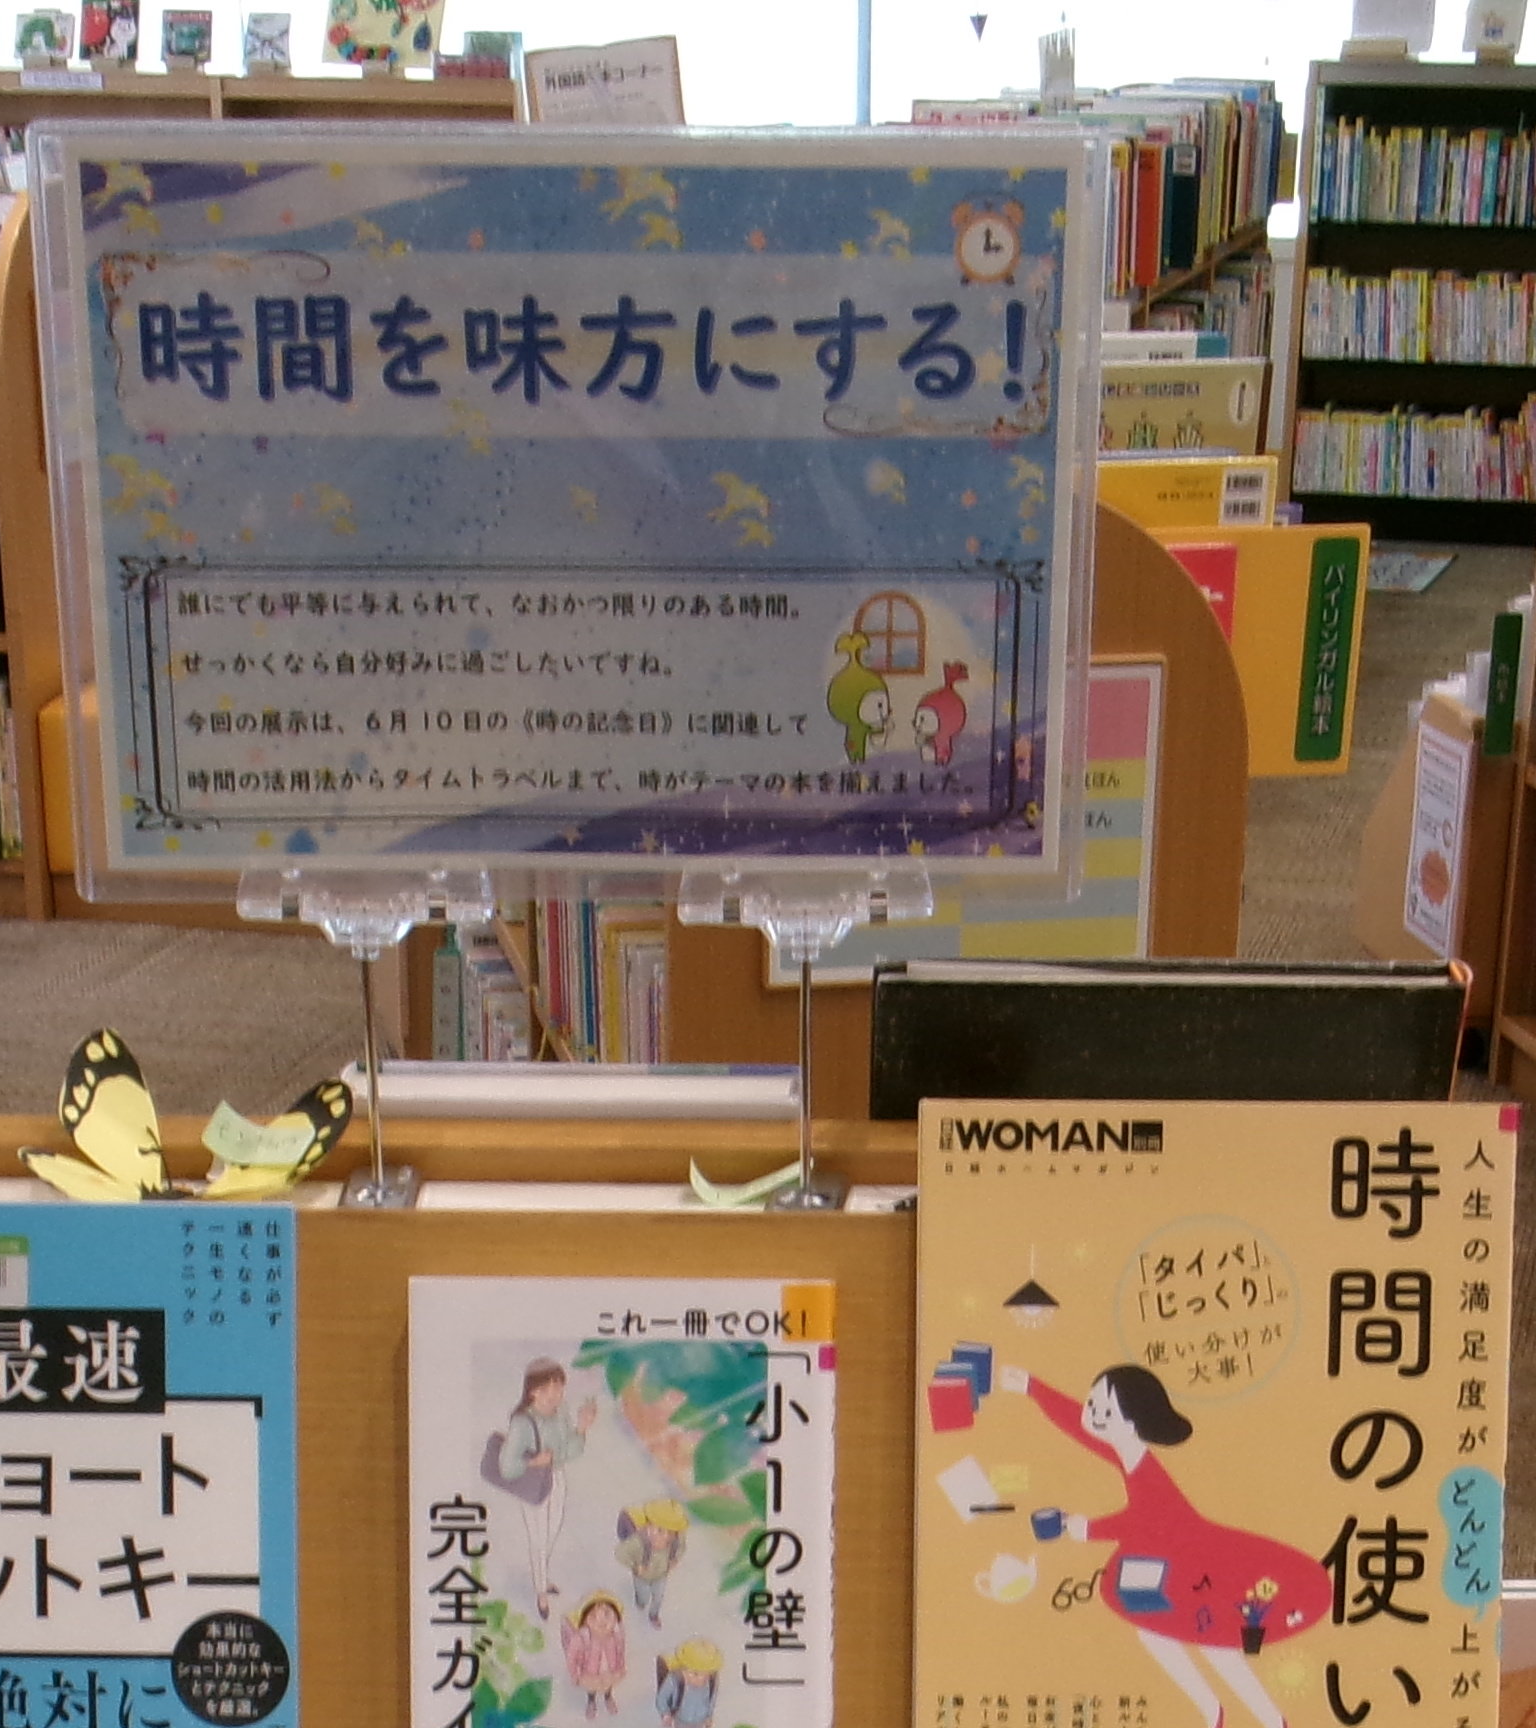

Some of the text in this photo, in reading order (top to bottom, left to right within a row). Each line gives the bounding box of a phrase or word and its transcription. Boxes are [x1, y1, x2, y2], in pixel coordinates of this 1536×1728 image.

[137, 293, 1031, 405] 時間を味方にする！
[178, 591, 803, 621] 誰にでも平等に与えられて、なおかつ限りのある時間。
[182, 650, 676, 679] せっかくなら自分好みに過ごしたいですね。
[187, 766, 979, 798] 時間の活用法からタイムトラベルまで、時がテーマの本を揃えました。
[955, 1119, 1132, 1153] WOMAN
[180, 1218, 198, 1326] テクニック
[207, 1222, 226, 1326] 一生モノの
[236, 1218, 254, 1306] 速くなる
[265, 1218, 282, 1328] 仕事が必ず
[597, 1307, 809, 1337] これ一冊でOK！
[1144, 1325, 1284, 1367] 使い分けが
[205, 1623, 255, 1641] 本当に
[198, 1642, 263, 1660] 効果的な
